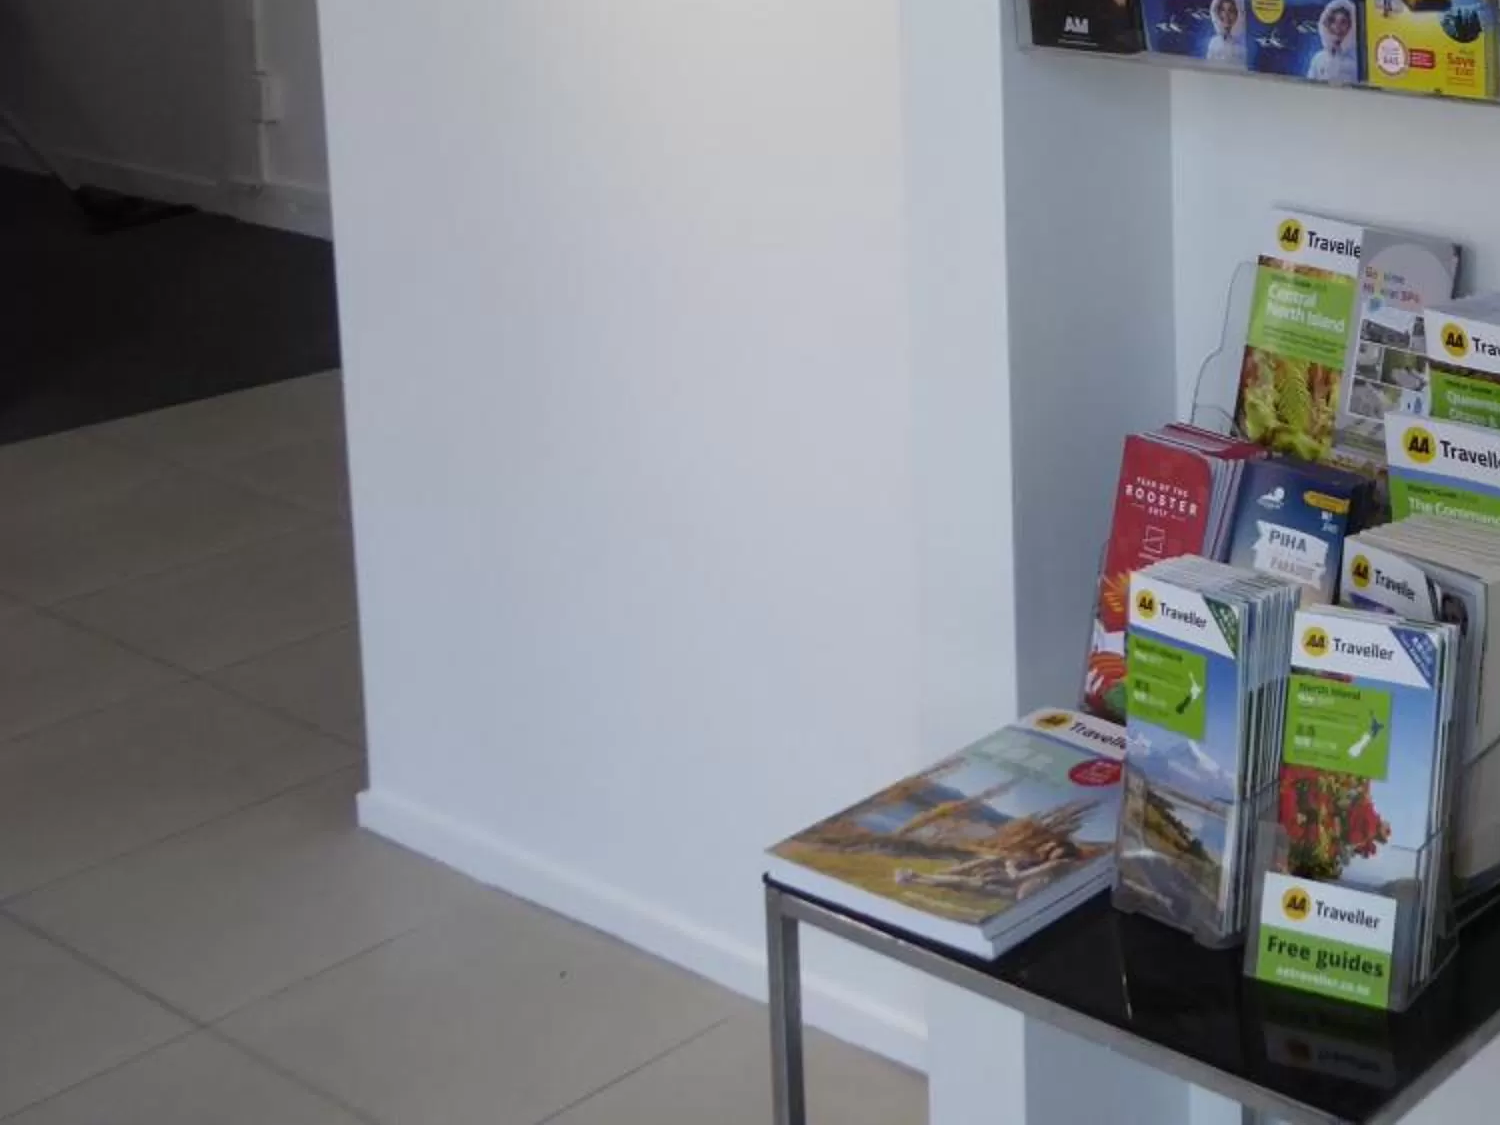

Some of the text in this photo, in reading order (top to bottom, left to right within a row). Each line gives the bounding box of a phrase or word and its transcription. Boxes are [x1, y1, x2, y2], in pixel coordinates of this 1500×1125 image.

[1063, 18, 1090, 36] AM
[1307, 230, 1361, 259] Travelle
[1266, 299, 1345, 333] North Island
[1408, 435, 1430, 454] AA
[1125, 483, 1199, 517] ROOSTER
[1408, 495, 1432, 514] The
[1268, 529, 1308, 554] PIHA
[1159, 602, 1207, 629] Traveller
[1332, 637, 1395, 662] Traveller
[1315, 898, 1381, 929] Traveller
[1266, 934, 1384, 978] Free guides
